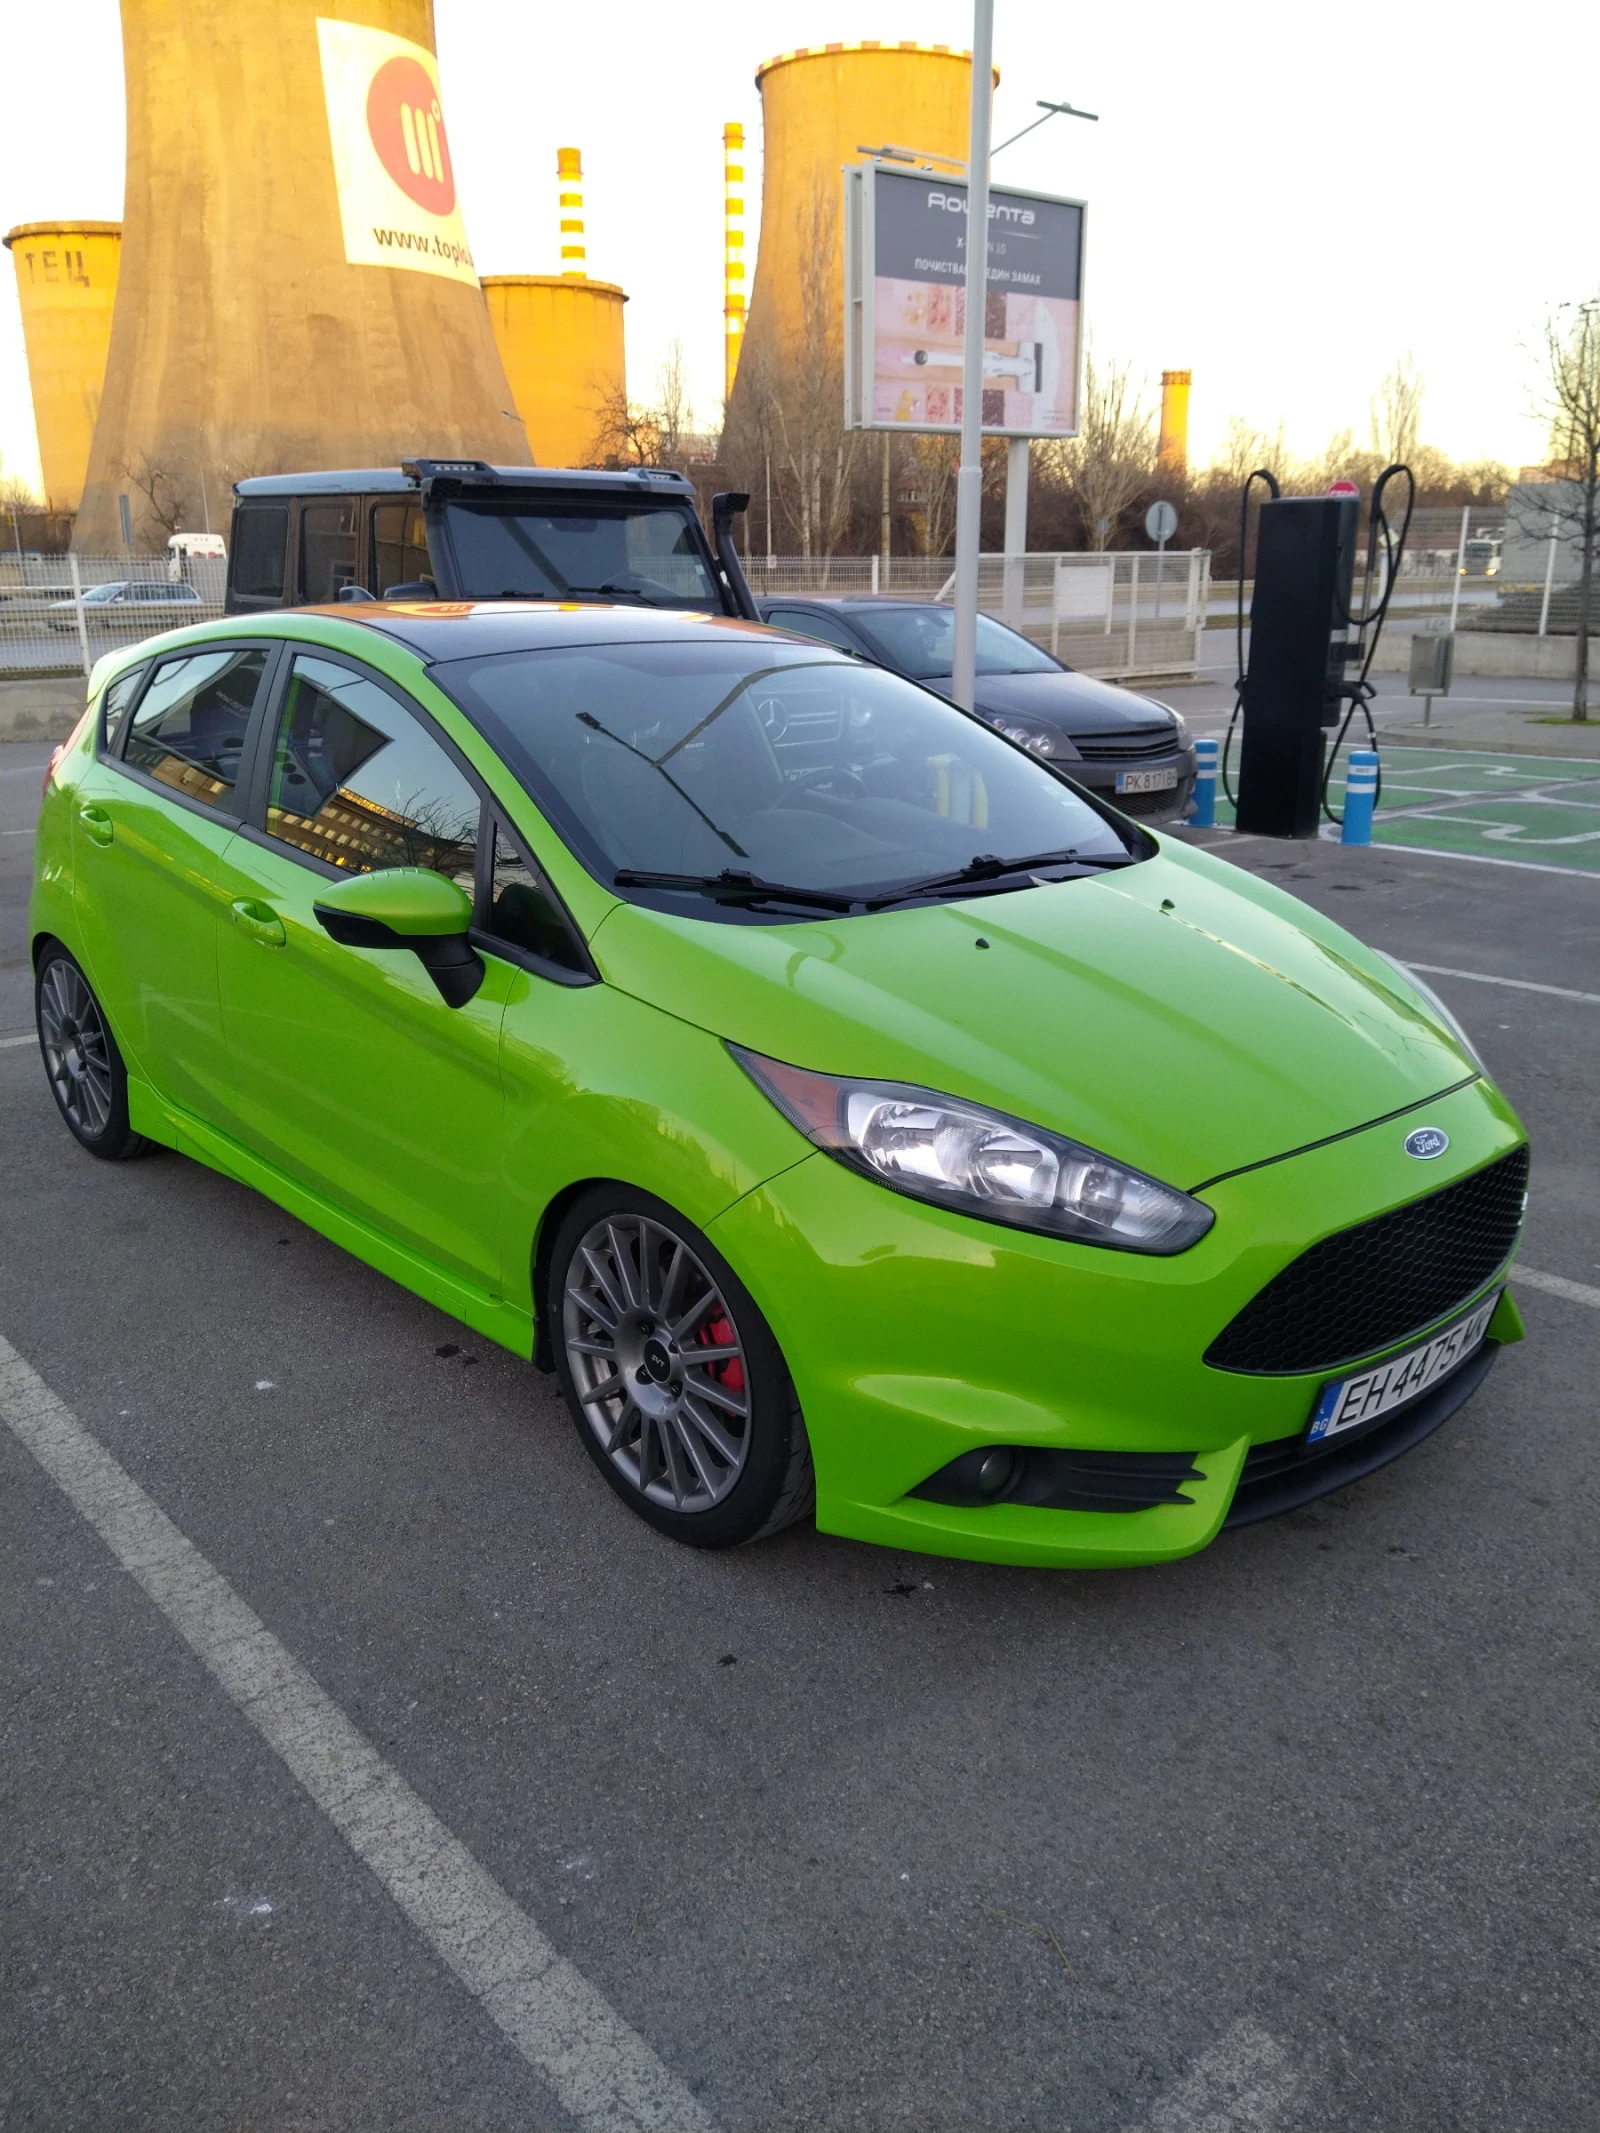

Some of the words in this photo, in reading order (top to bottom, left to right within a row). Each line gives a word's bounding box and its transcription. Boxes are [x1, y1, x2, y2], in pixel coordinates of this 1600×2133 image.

[25, 250, 90, 288] ТЕЦ
[1414, 1133, 1441, 1154] Ford
[1335, 1366, 1394, 1426] EH
[1391, 1327, 1463, 1398] 4475
[1310, 1418, 1329, 1434] BG
